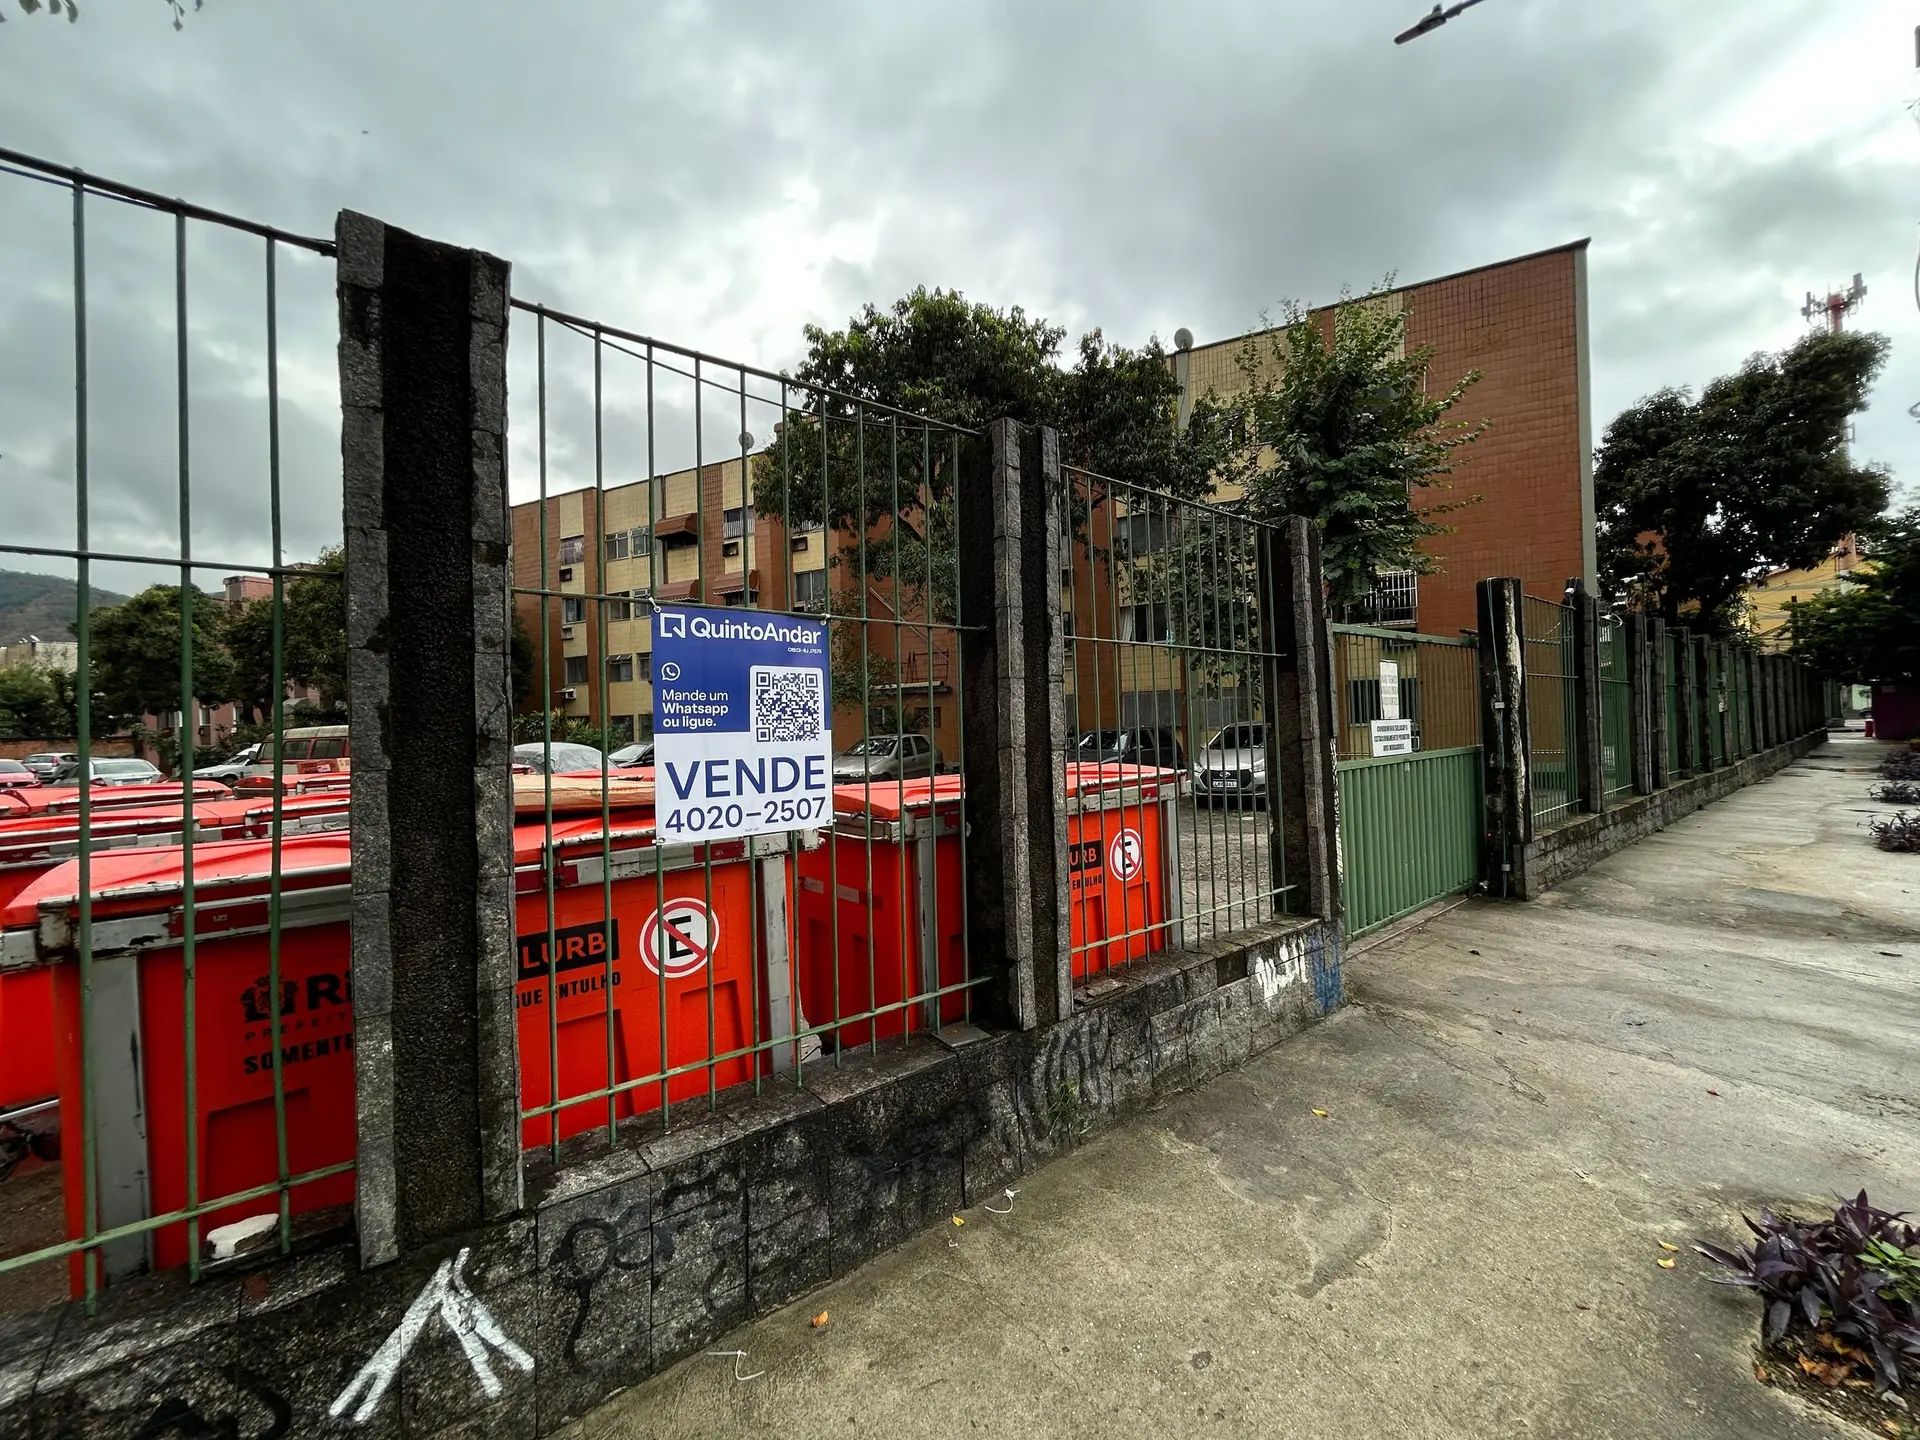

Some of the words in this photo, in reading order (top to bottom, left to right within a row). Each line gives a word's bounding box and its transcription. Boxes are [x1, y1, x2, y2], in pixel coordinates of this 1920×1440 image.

[690, 617, 822, 645] QuintoAndar
[662, 689, 707, 701] Mande
[709, 691, 729, 701] um
[662, 702, 729, 716] Whatsapp
[663, 718, 681, 727] ou
[682, 716, 717, 729] ligue.
[664, 755, 826, 800] VENDE
[665, 796, 826, 833] 4020-2507
[1072, 874, 1102, 891] ENULHO
[523, 932, 606, 969] LURB
[667, 914, 694, 961] E
[516, 988, 543, 1009] UE
[555, 971, 621, 999] NTULHO
